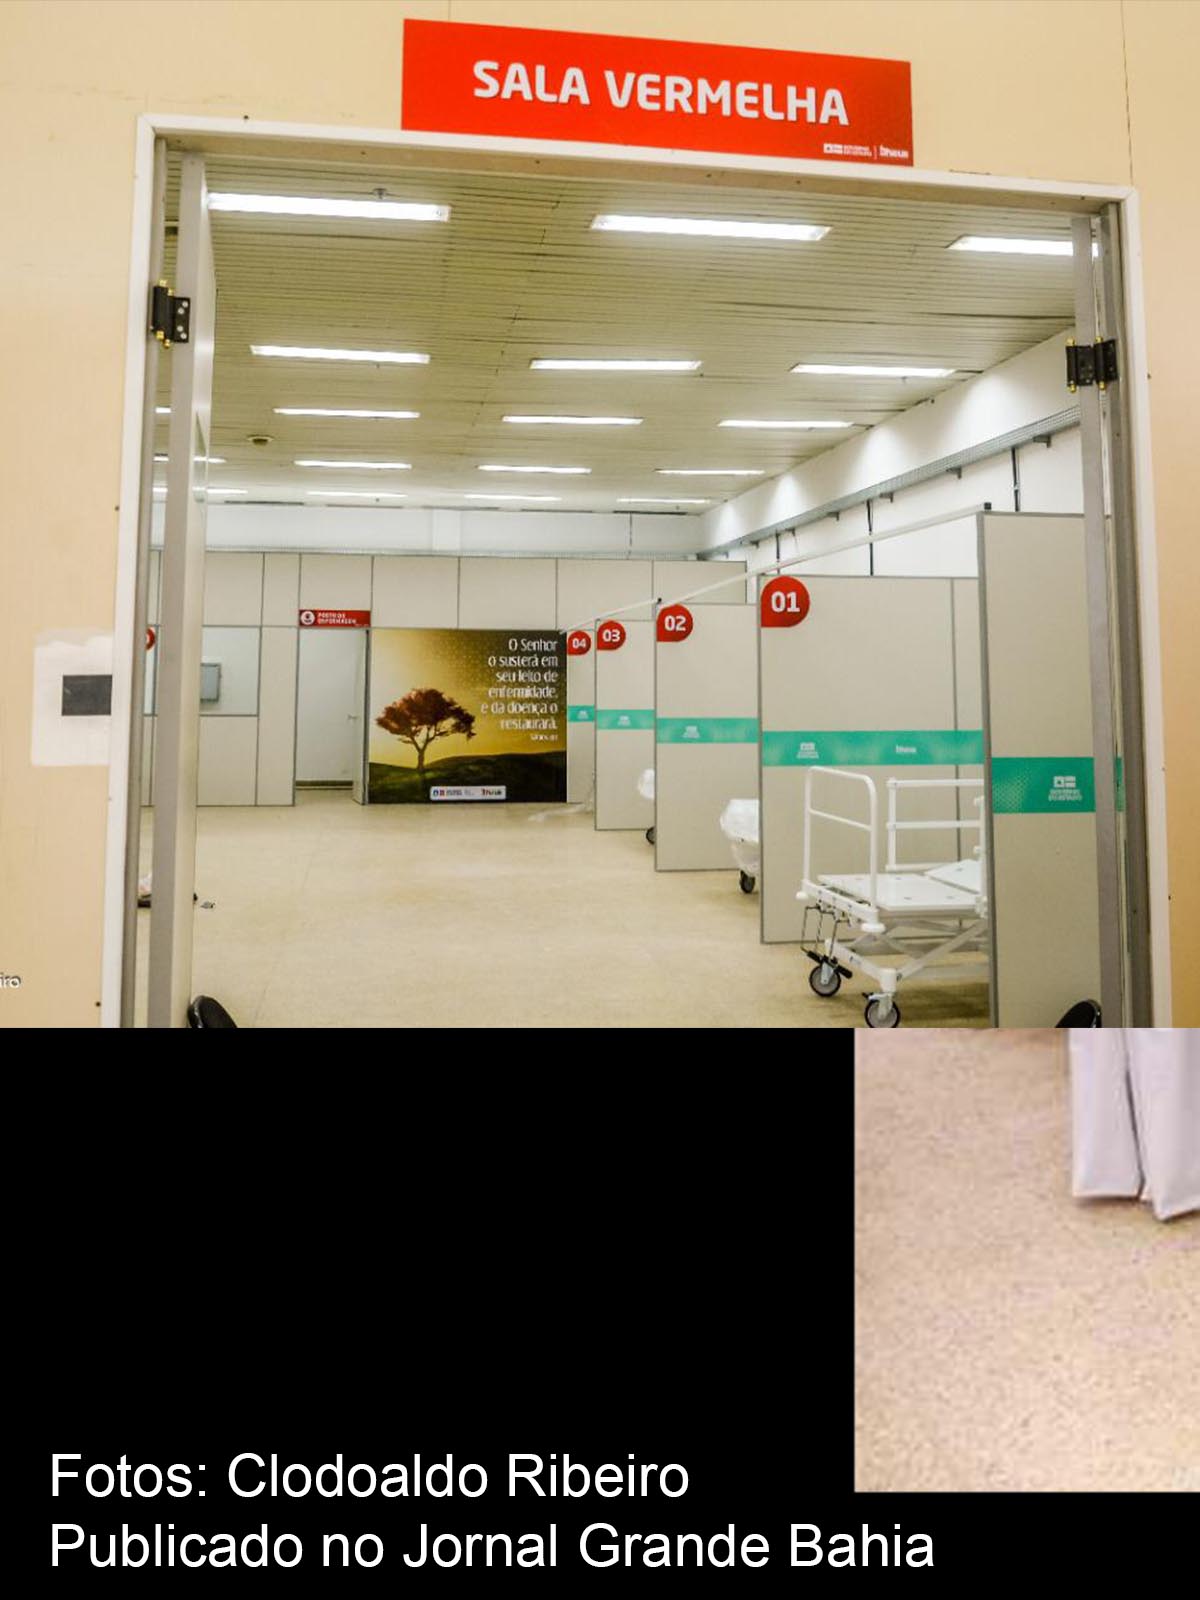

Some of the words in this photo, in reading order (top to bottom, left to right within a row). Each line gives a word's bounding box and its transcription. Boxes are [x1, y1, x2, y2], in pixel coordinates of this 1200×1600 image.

[473, 60, 590, 105] SALA
[604, 70, 849, 125] VERMELHA
[771, 591, 801, 613] 01
[664, 615, 687, 632] 02
[572, 637, 587, 649] 04
[602, 629, 621, 643] 03
[508, 638, 518, 651] O
[520, 638, 558, 651] Senhor
[499, 654, 539, 667] susterá
[541, 655, 559, 667] em
[496, 671, 516, 682] seu
[518, 670, 541, 682] leito
[543, 670, 559, 682] de
[481, 702, 488, 714] e
[491, 702, 505, 714] da
[507, 701, 548, 716] doença
[550, 702, 558, 714] o
